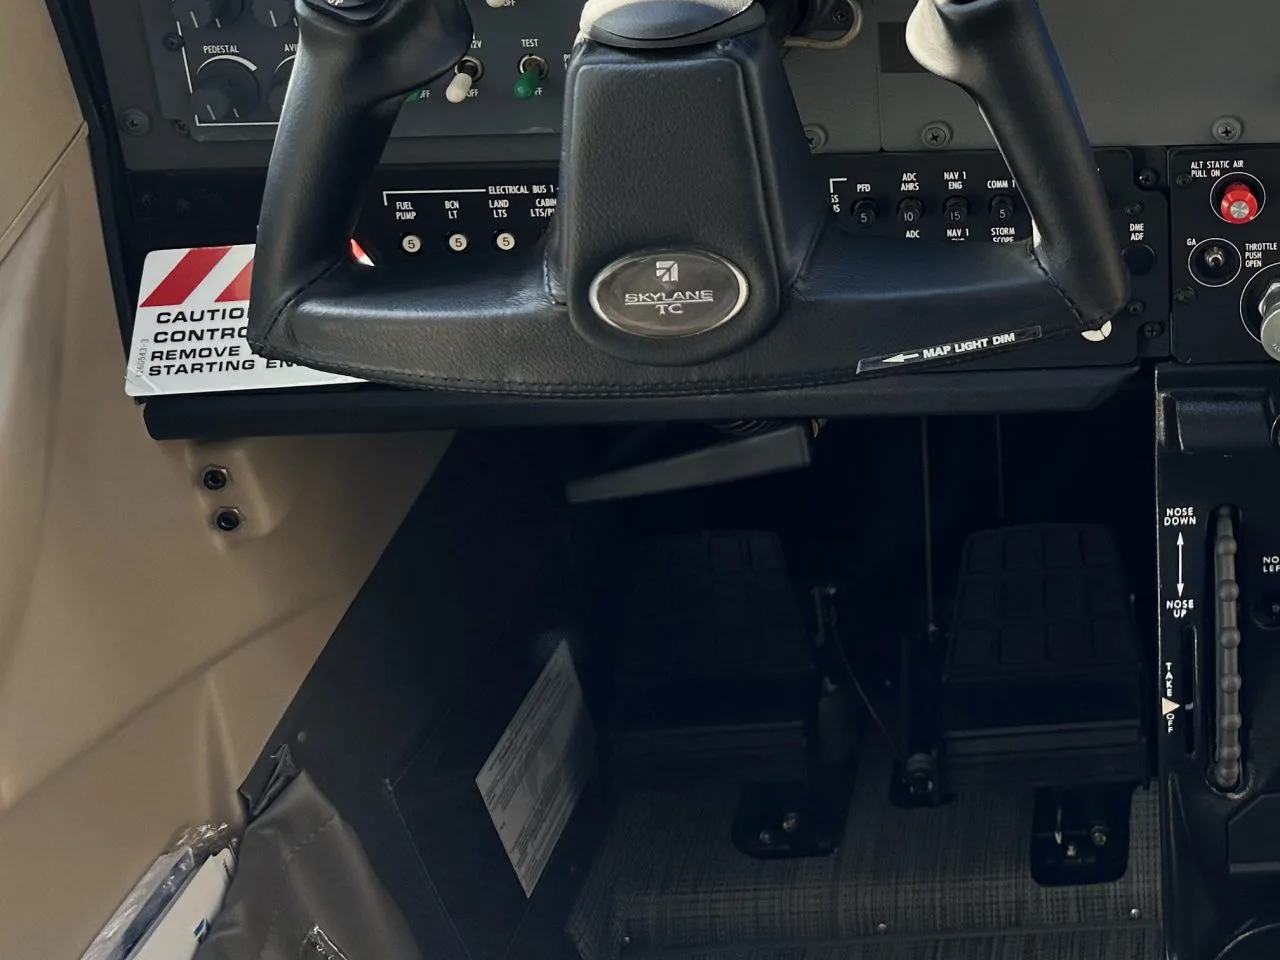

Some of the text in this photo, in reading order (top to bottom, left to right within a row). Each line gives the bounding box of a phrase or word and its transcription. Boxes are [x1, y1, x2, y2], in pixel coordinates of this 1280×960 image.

[204, 46, 239, 54] PEDESTAL
[1207, 160, 1230, 168] STATIC
[488, 186, 529, 194] ELECTRICAL
[532, 185, 547, 194] BUS
[857, 184, 870, 192] PFD
[396, 202, 413, 210] FUEL
[490, 199, 509, 208] LAND
[396, 211, 416, 220] PUMP
[494, 210, 506, 218] LTS
[1246, 243, 1277, 251] THROTTLE
[625, 290, 714, 302] SKYLANE
[656, 304, 684, 314] TC
[923, 332, 1015, 359] MAP LIGHT DIM
[151, 346, 240, 362] REMOVE
[149, 360, 254, 376] STARTING
[1166, 508, 1194, 516] NOSE
[1164, 516, 1196, 526] DOWN
[1166, 600, 1194, 609] NOSE
[1174, 609, 1186, 618] UP
